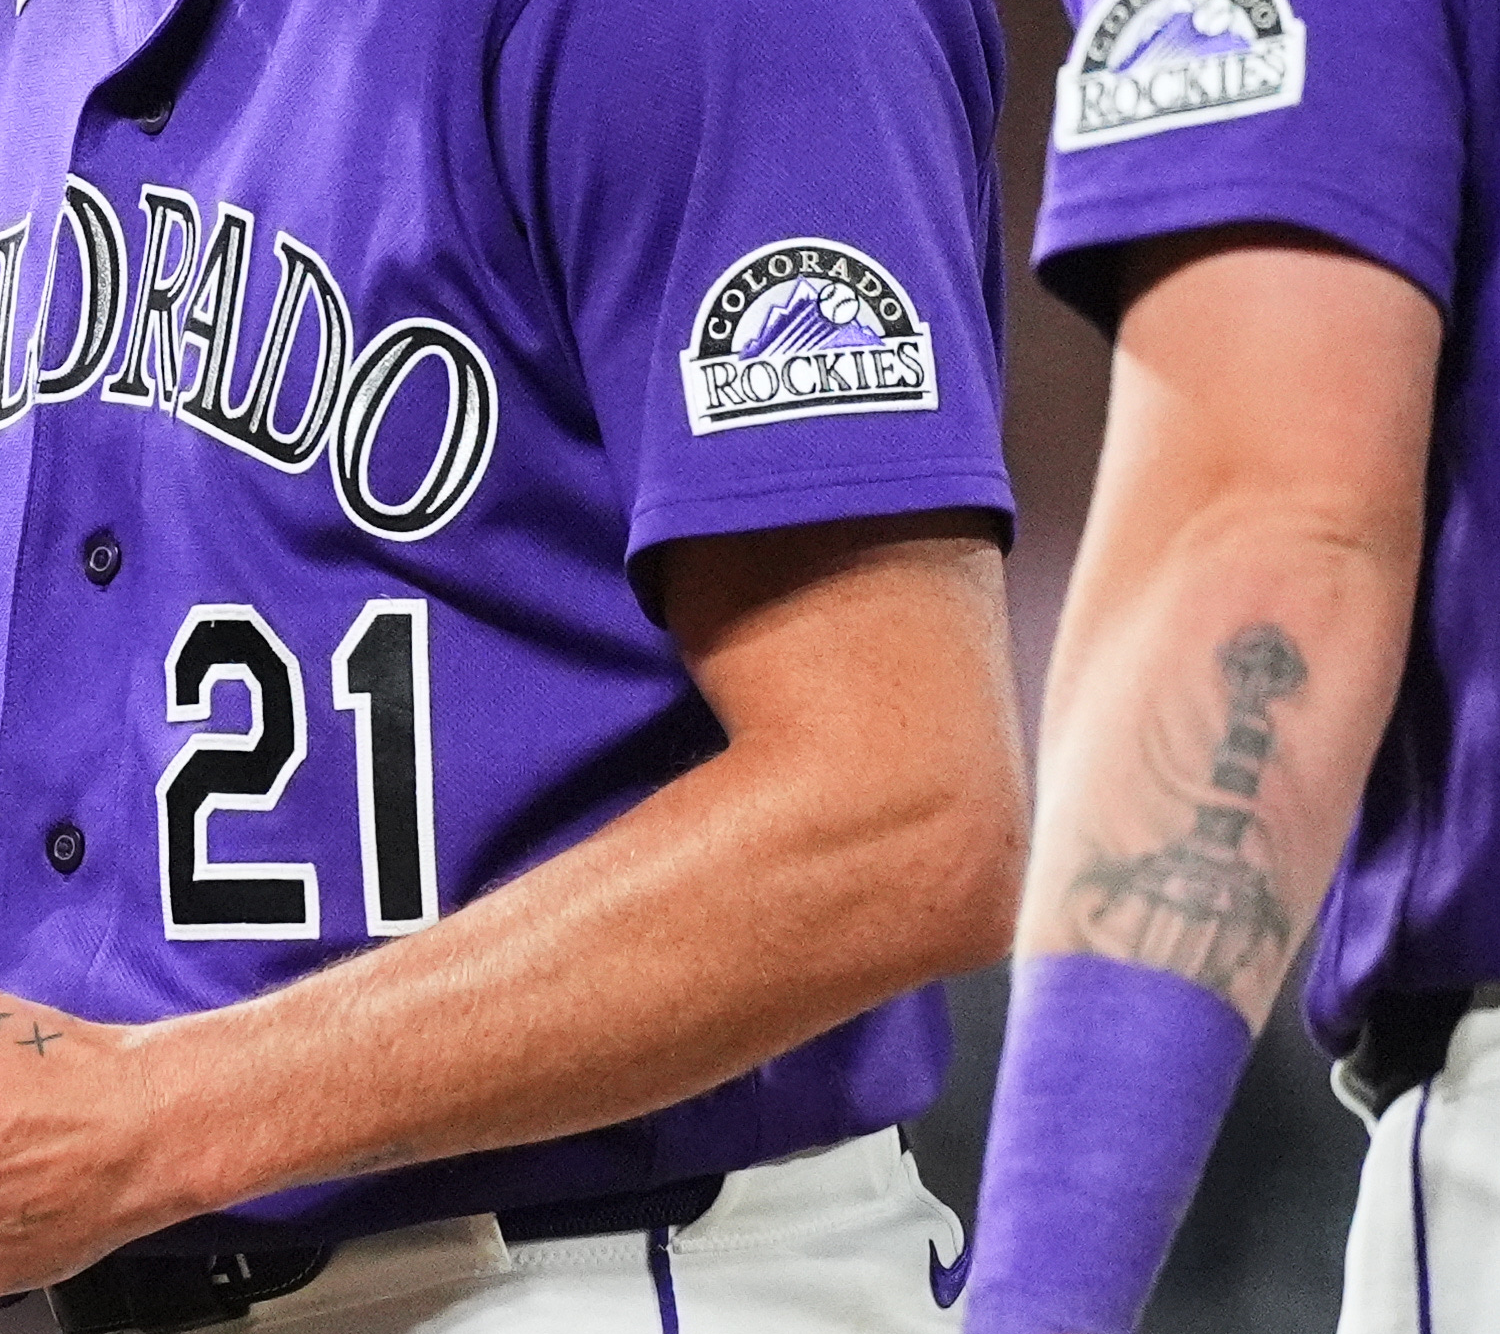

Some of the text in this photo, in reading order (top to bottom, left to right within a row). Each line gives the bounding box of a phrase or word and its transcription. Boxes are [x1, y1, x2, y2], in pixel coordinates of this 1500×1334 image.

[707, 249, 903, 341] COLORADO
[701, 341, 926, 410] ROCKIES
[155, 598, 440, 941] 21
